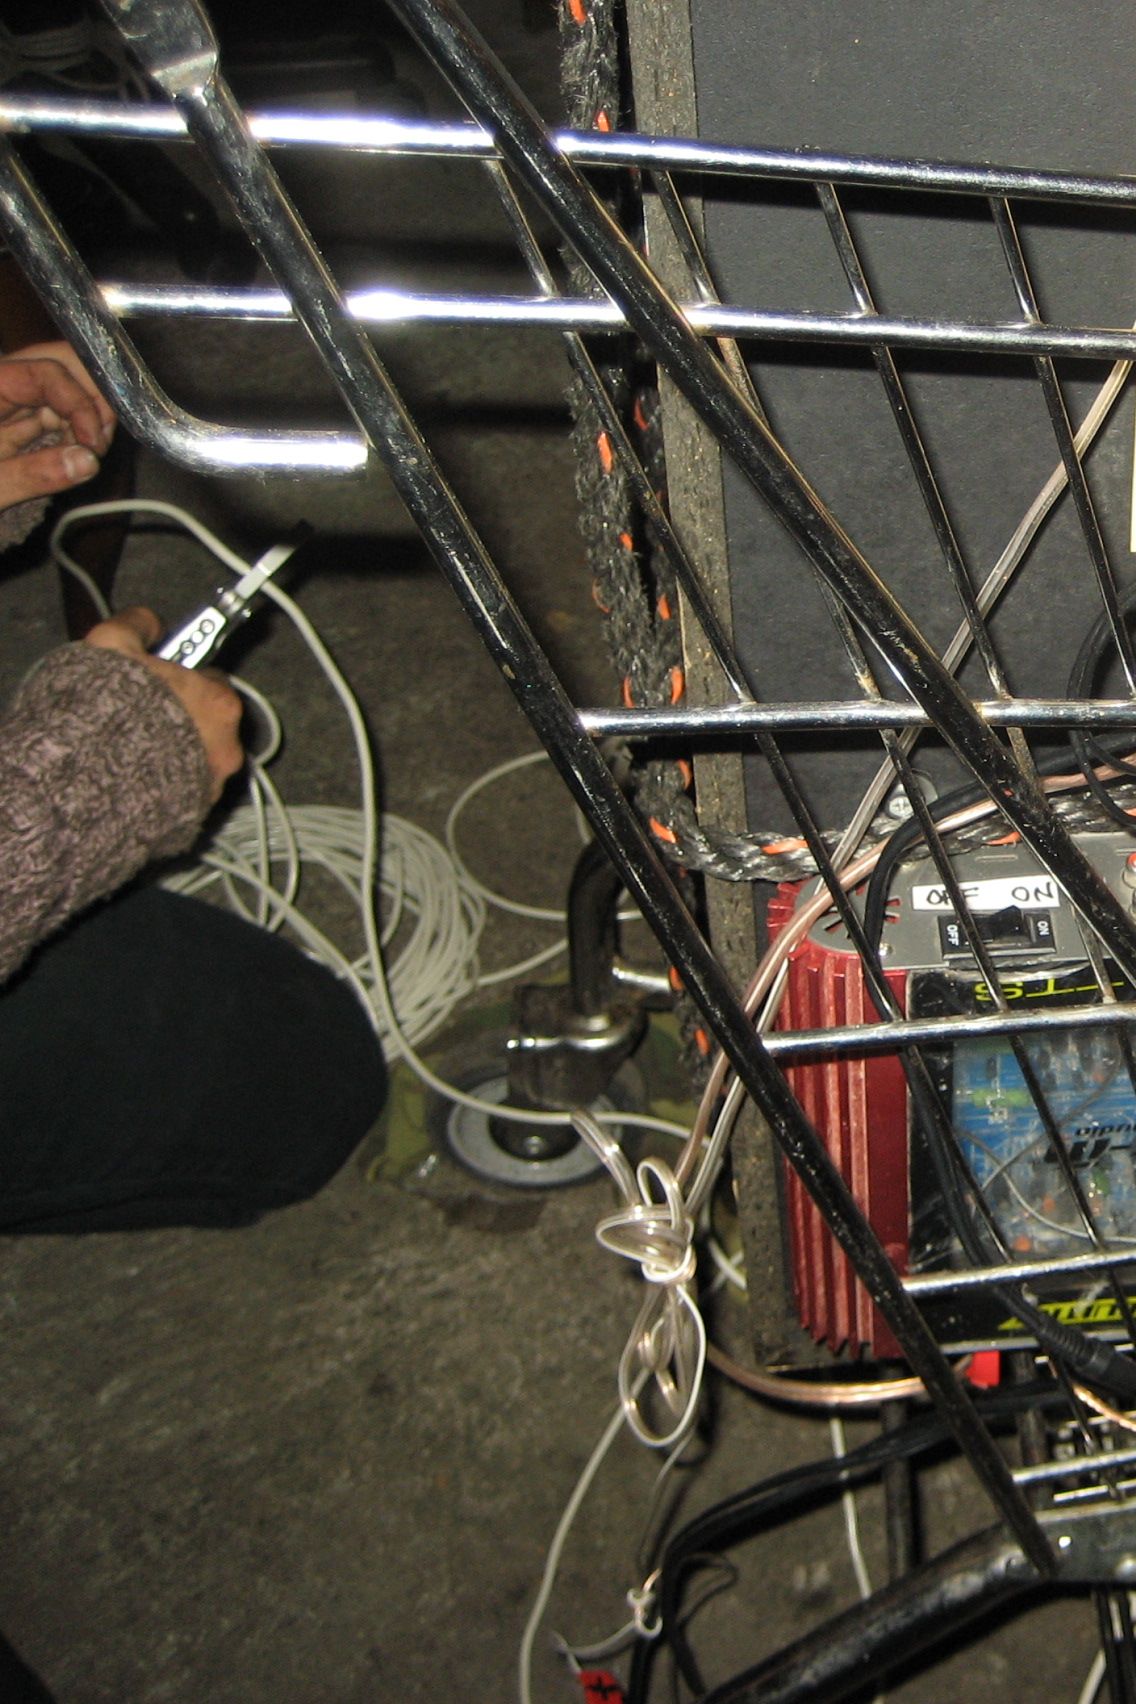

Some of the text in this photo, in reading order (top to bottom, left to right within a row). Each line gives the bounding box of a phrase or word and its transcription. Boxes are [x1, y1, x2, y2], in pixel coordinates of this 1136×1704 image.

[1012, 882, 1054, 902] ON
[947, 924, 959, 946] OFF
[1037, 921, 1049, 936] ON
